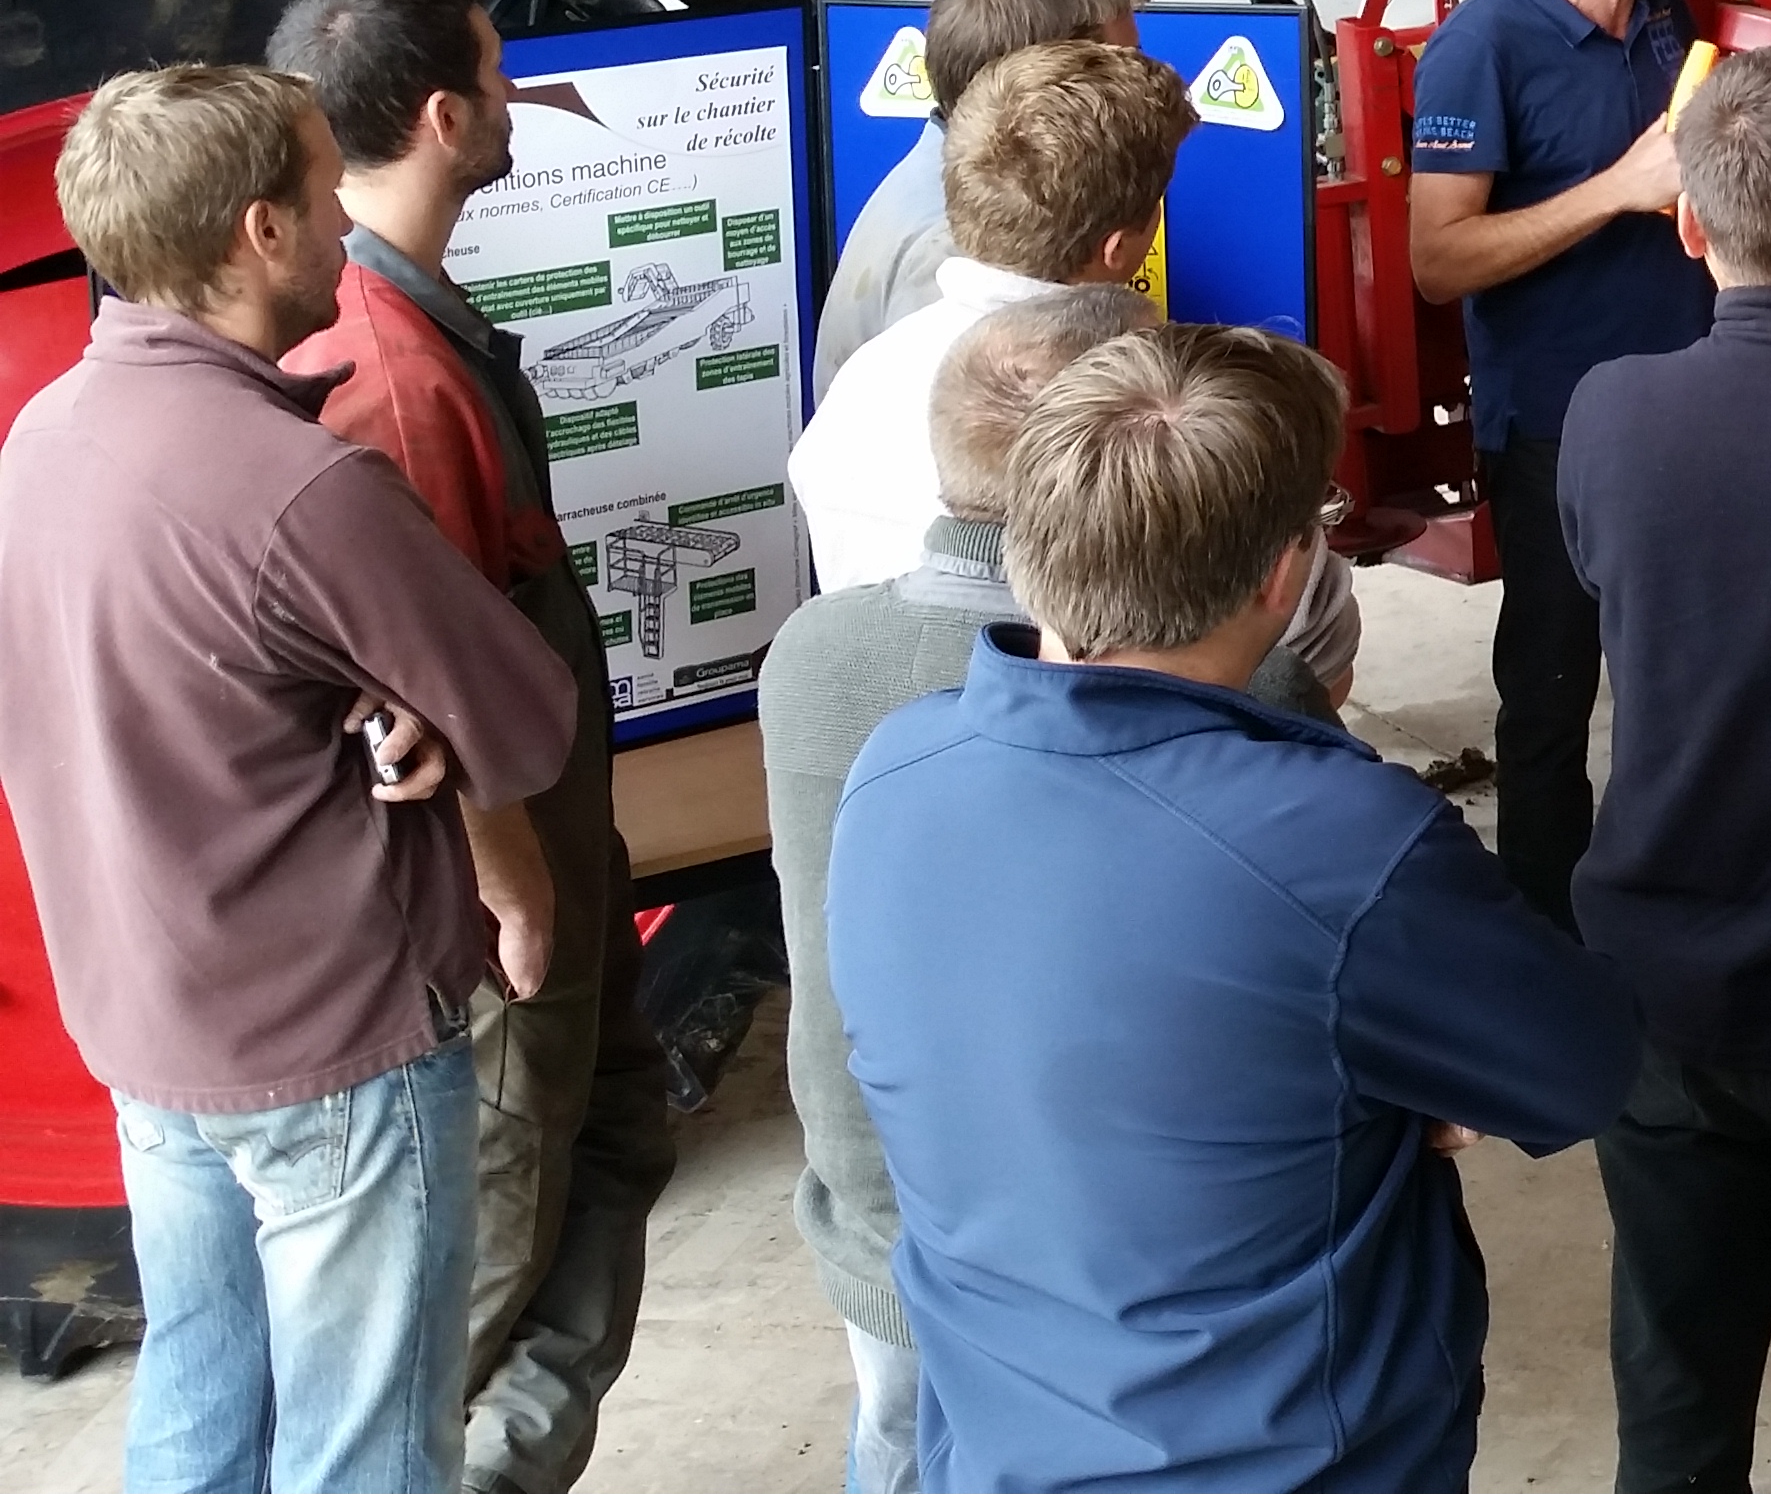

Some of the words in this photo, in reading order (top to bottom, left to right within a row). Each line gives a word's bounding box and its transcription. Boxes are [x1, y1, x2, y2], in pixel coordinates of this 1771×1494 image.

[695, 64, 775, 93] Sécurité
[636, 112, 669, 130] sur
[673, 106, 691, 125] le
[696, 98, 777, 123] chantier
[1436, 116, 1476, 130] BETTER
[686, 133, 708, 153] de
[713, 126, 777, 149] récolte
[1440, 127, 1474, 139] BEACH
[571, 153, 668, 183] machine
[480, 199, 544, 220] normes,
[550, 184, 643, 209] Certification
[644, 207, 682, 221] disposition
[727, 216, 758, 227] Disposer
[617, 223, 653, 236] spécifique
[655, 220, 671, 230] pour
[672, 215, 700, 227] nettoyer
[726, 227, 749, 237] moyen
[442, 244, 480, 258] heuse
[546, 268, 582, 282] protection
[584, 266, 598, 274] des
[531, 285, 545, 293] des
[580, 275, 608, 286] mobiles
[496, 302, 514, 310] avec
[515, 296, 550, 308] ouverture
[551, 288, 593, 302] uniquement
[594, 286, 606, 296] par
[557, 502, 614, 522] arracheuse
[617, 491, 667, 510] combinée
[696, 659, 749, 678] Groupama
